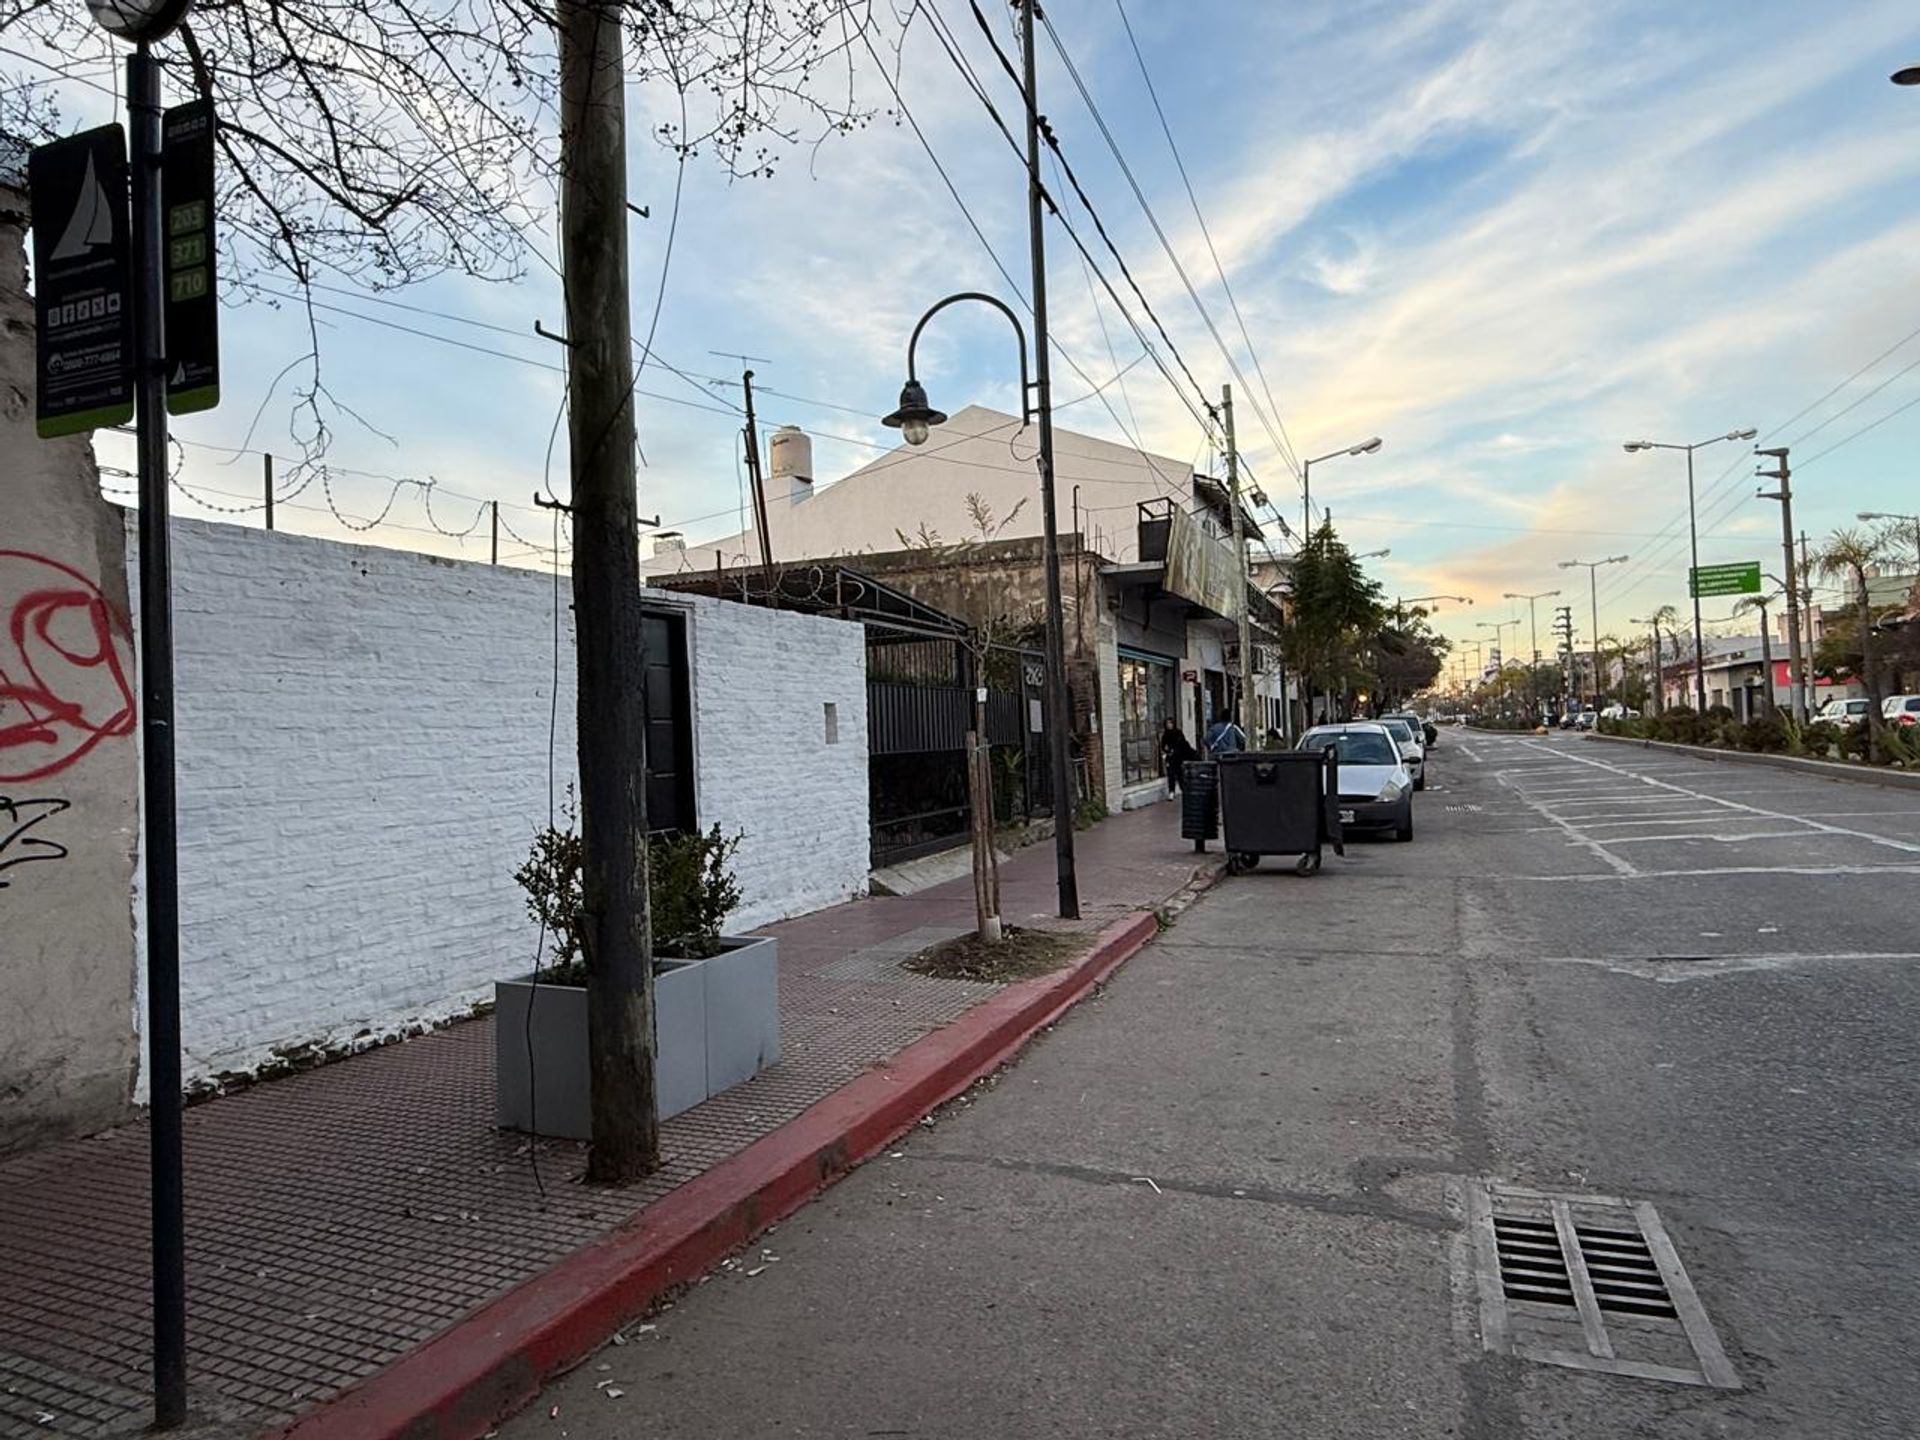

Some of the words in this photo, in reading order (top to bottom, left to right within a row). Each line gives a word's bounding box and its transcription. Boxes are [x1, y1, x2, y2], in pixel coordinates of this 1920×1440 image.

[173, 207, 201, 230] 203
[173, 241, 200, 263] 371
[174, 273, 202, 296] 710
